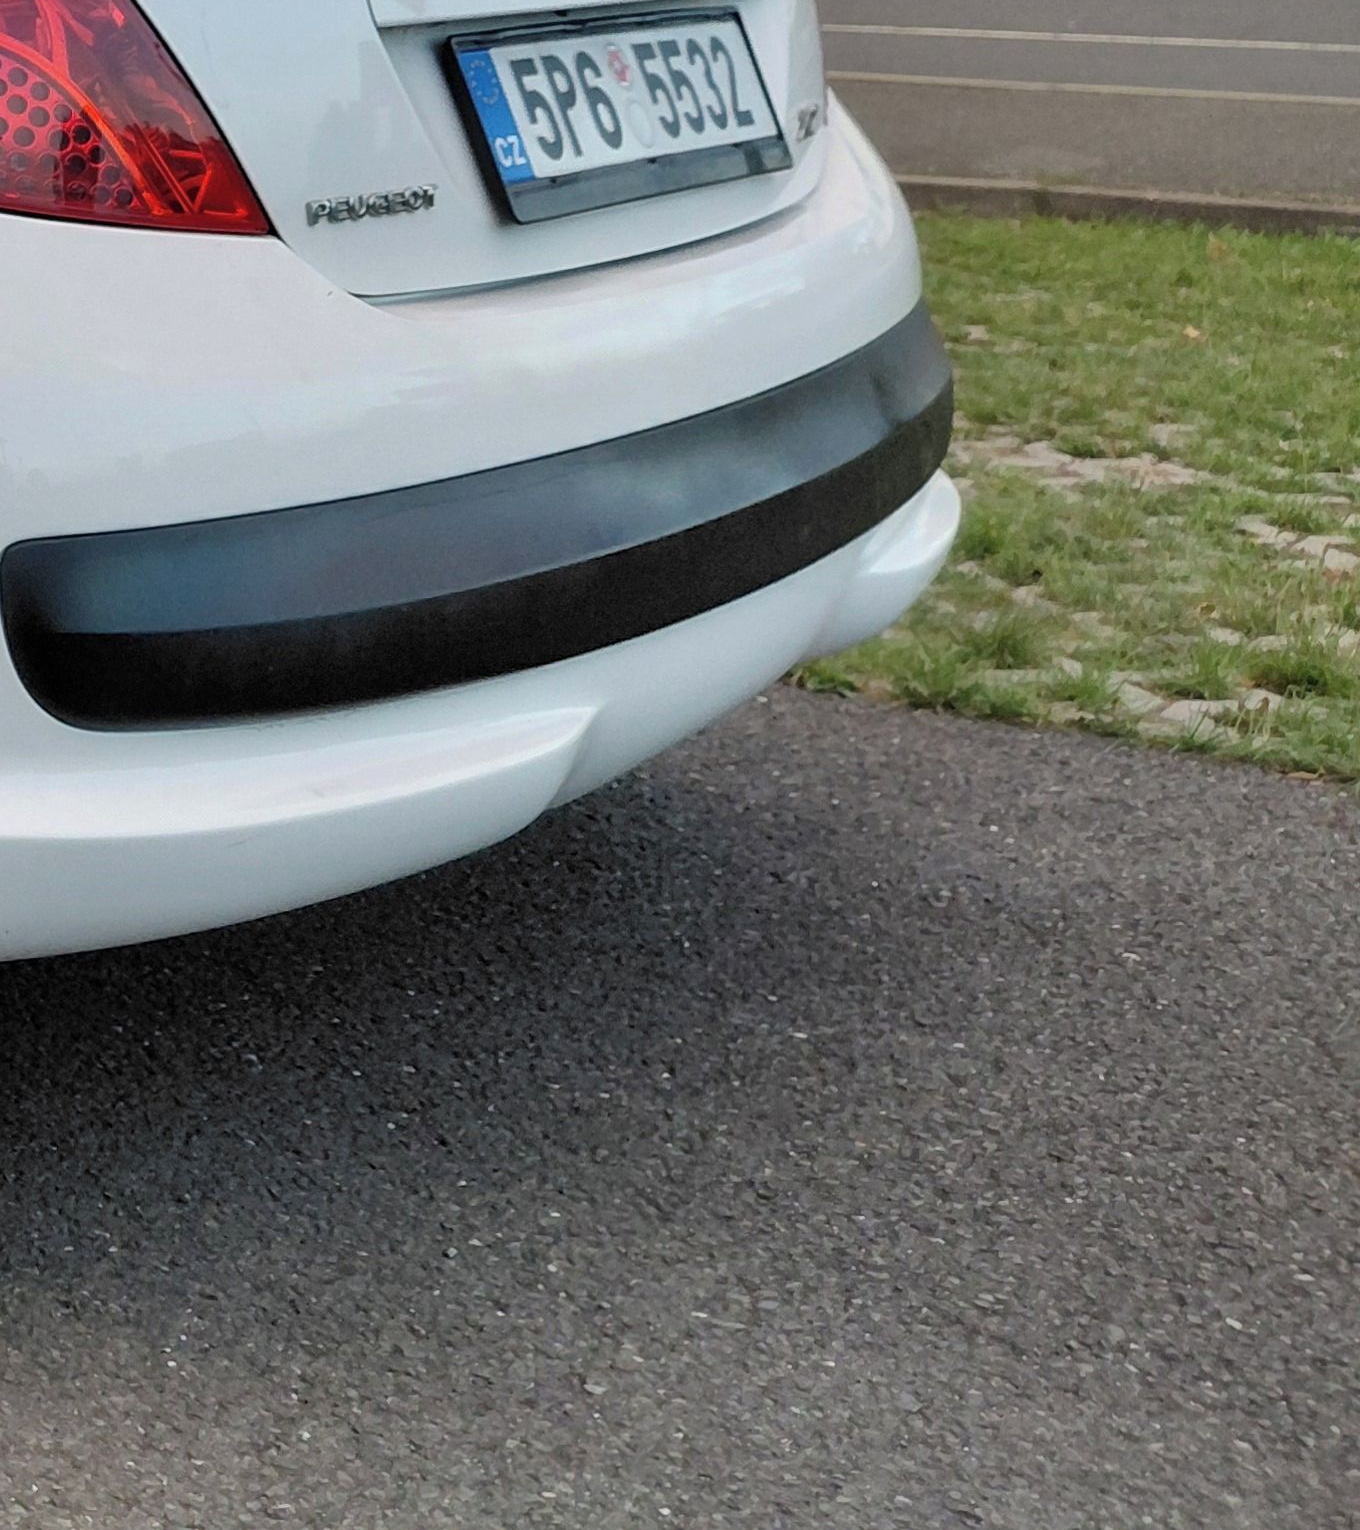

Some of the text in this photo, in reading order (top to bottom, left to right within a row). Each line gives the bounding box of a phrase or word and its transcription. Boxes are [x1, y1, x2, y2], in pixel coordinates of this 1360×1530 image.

[509, 35, 756, 162] 5P6 5532
[494, 134, 528, 168] CZ
[305, 183, 438, 227] PEUGEOT
